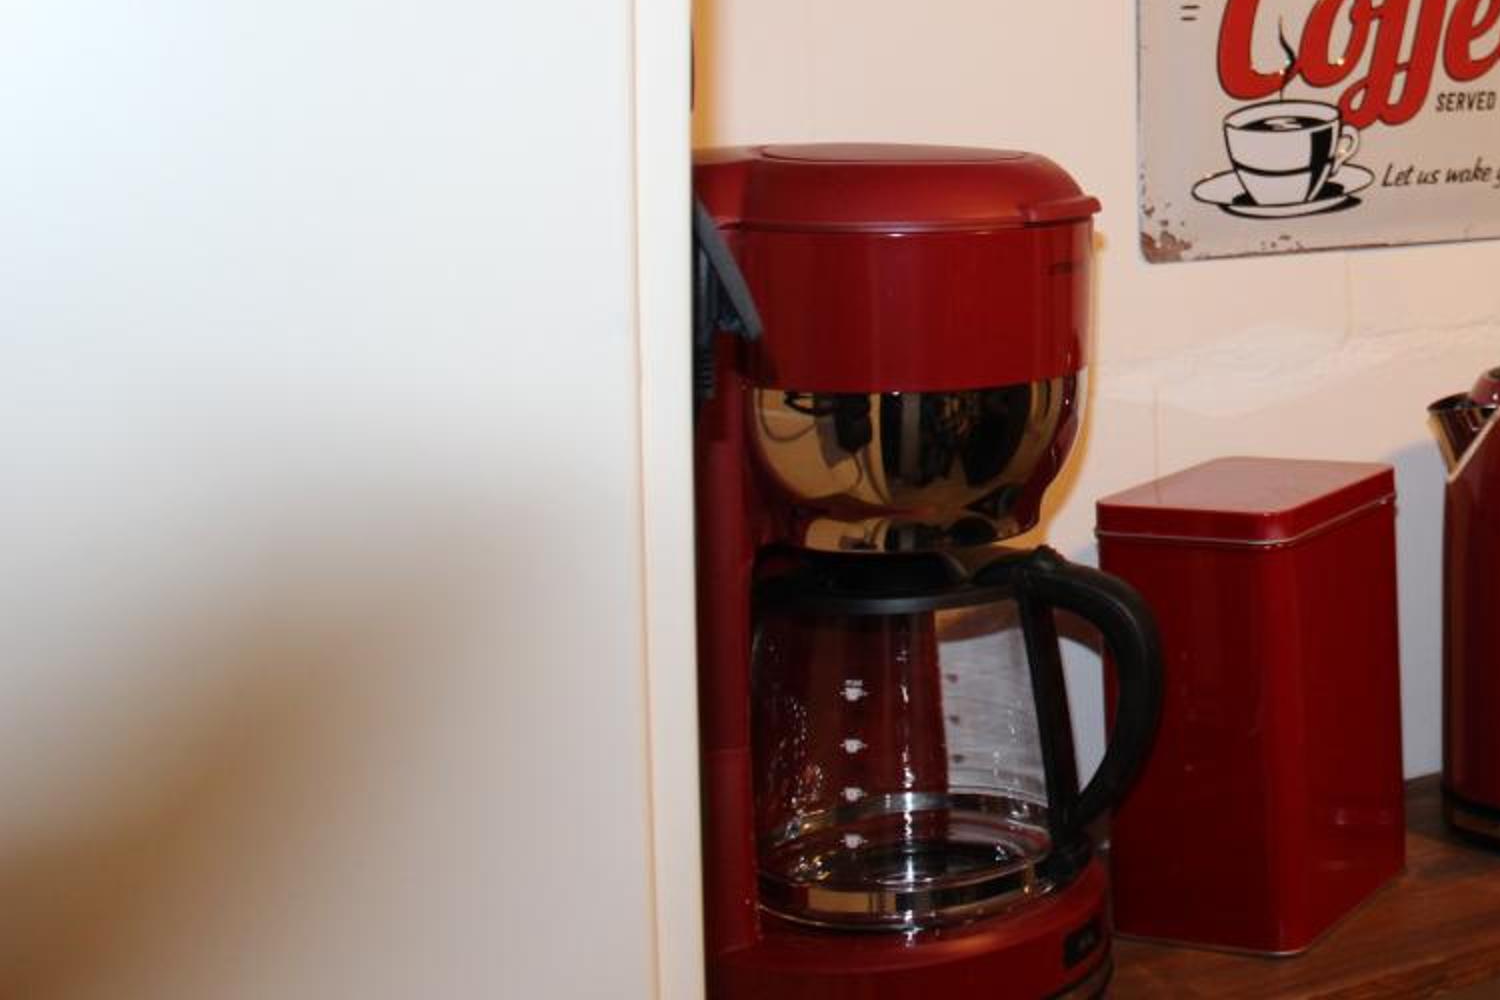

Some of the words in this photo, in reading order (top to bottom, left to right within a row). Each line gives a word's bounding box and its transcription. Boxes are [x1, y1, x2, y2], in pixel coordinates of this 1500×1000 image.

[1435, 90, 1497, 113] SERVED
[1380, 162, 1415, 188] Let
[1416, 168, 1442, 185] us
[1445, 155, 1492, 183] wake
